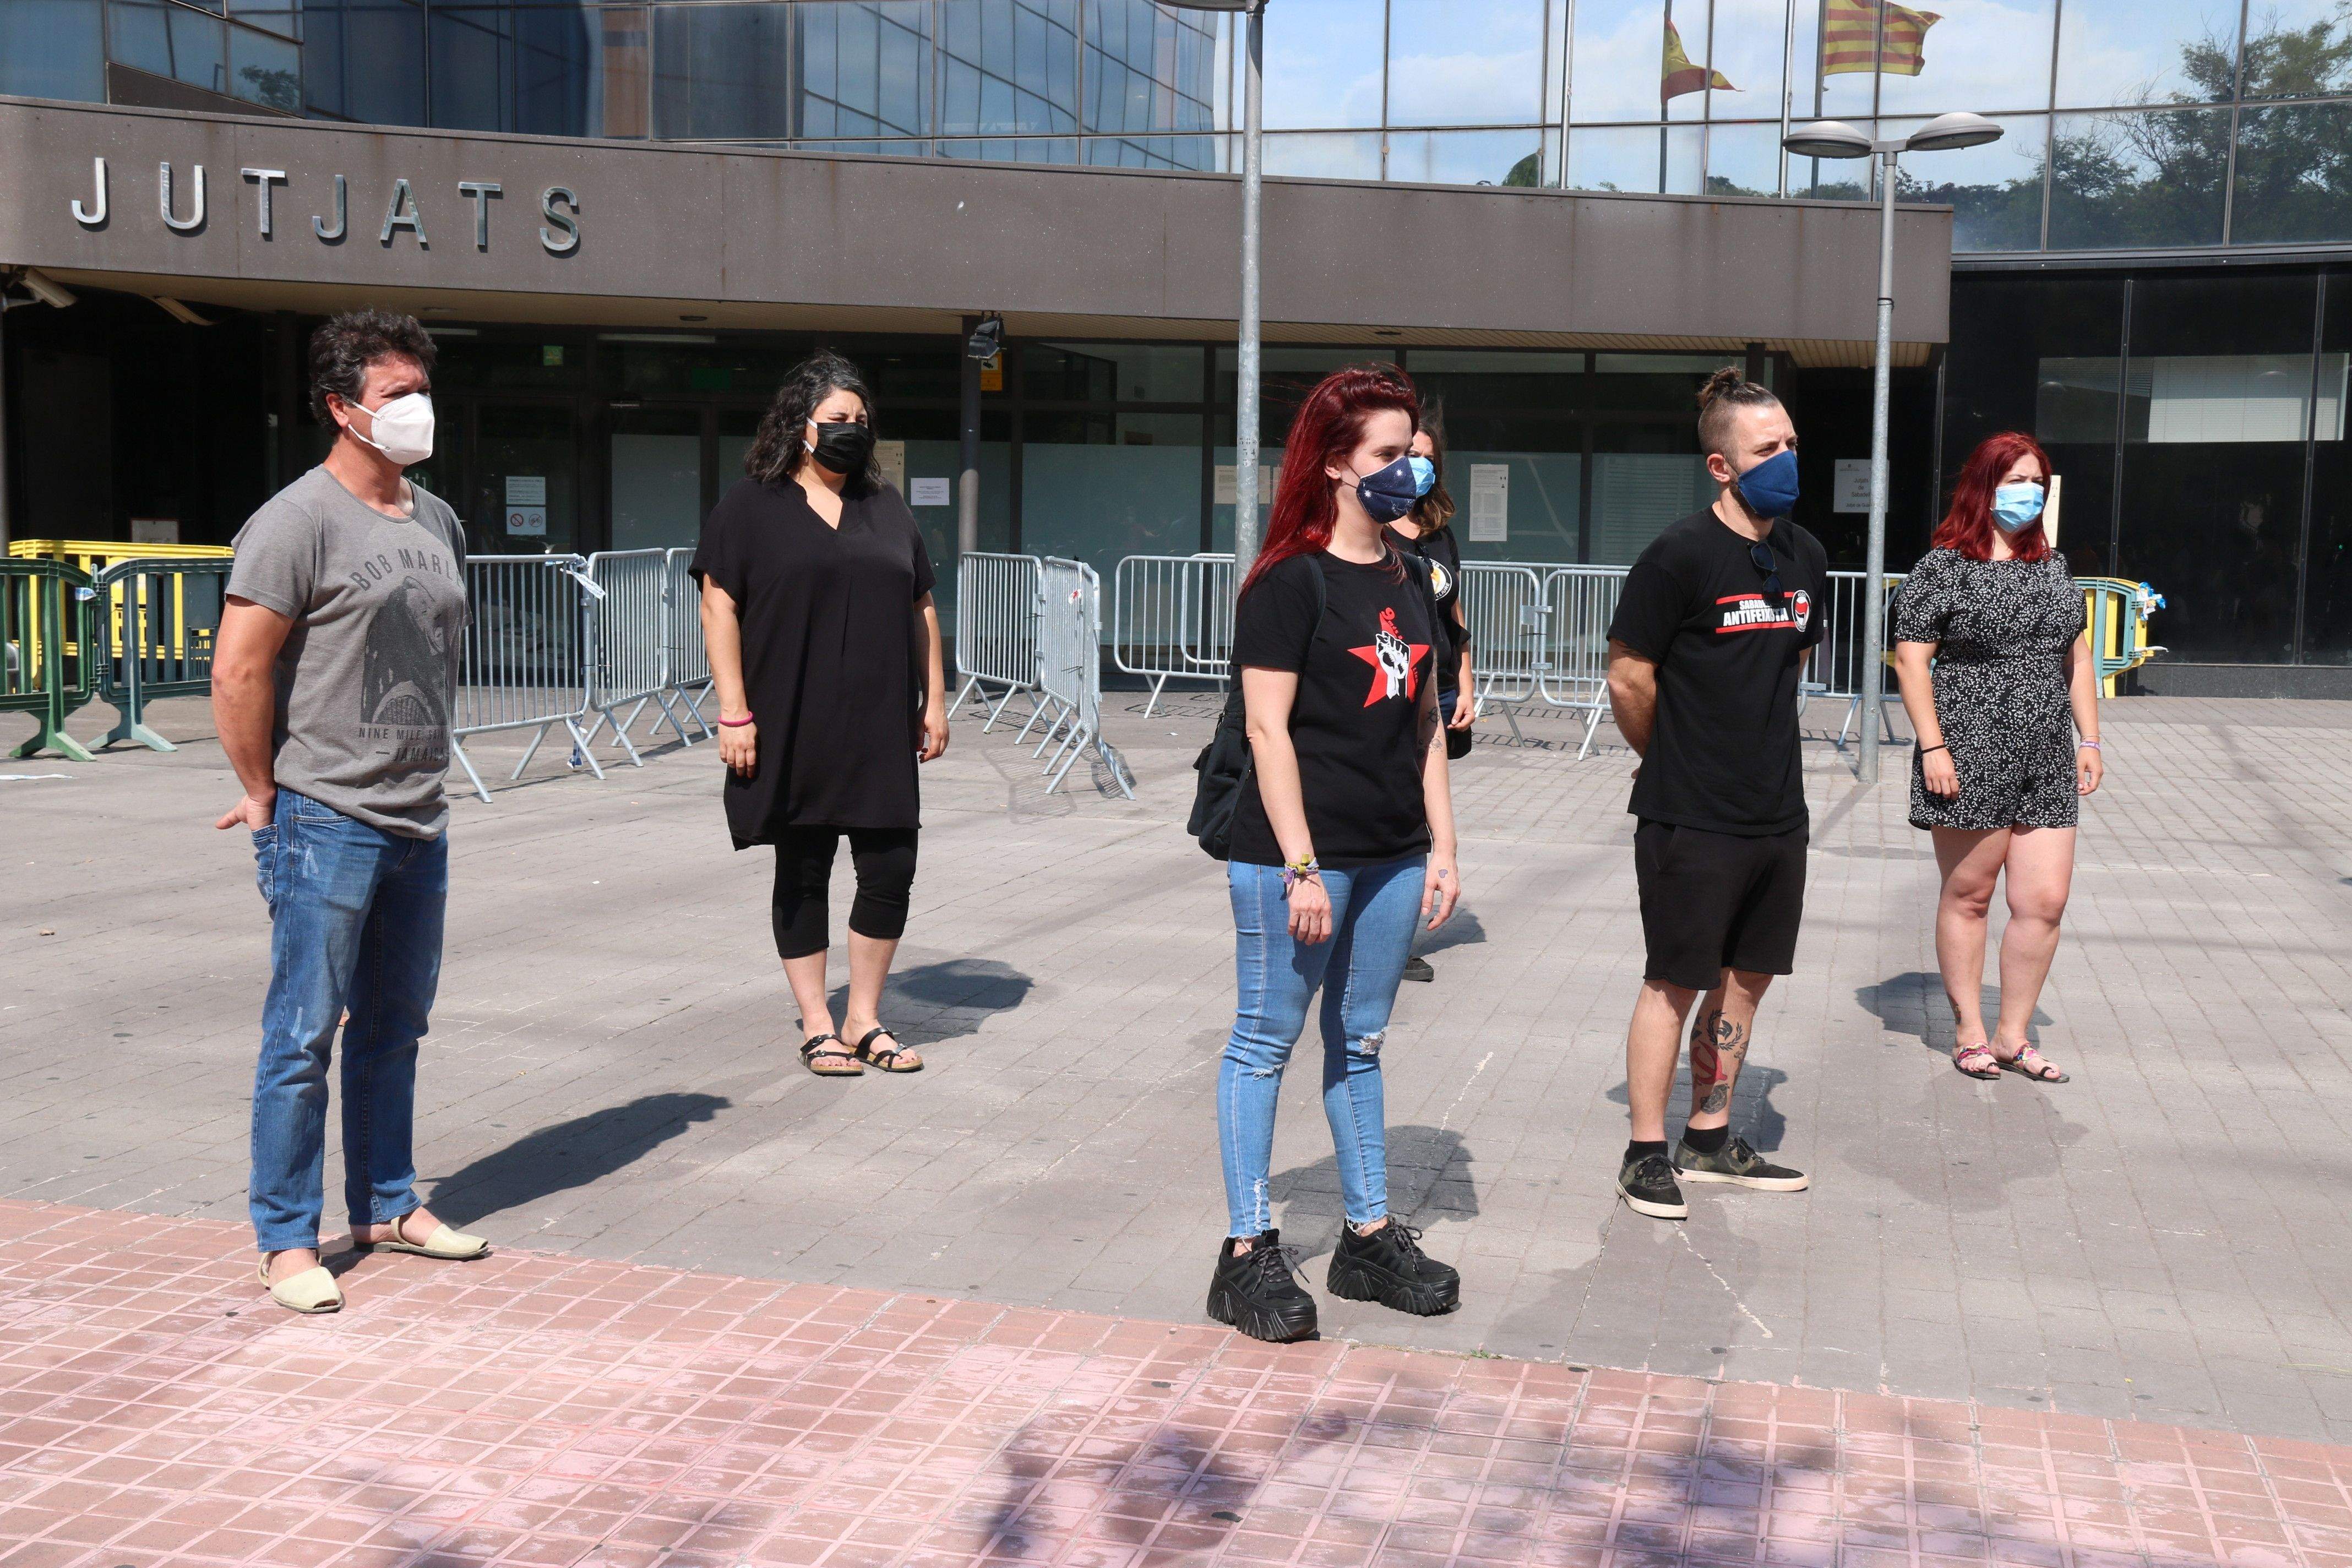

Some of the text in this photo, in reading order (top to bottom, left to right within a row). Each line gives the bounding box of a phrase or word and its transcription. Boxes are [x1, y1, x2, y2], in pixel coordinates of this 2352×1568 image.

[71, 157, 580, 252] JUTJATS
[349, 553, 393, 591] BOB
[358, 727, 389, 739] NINE
